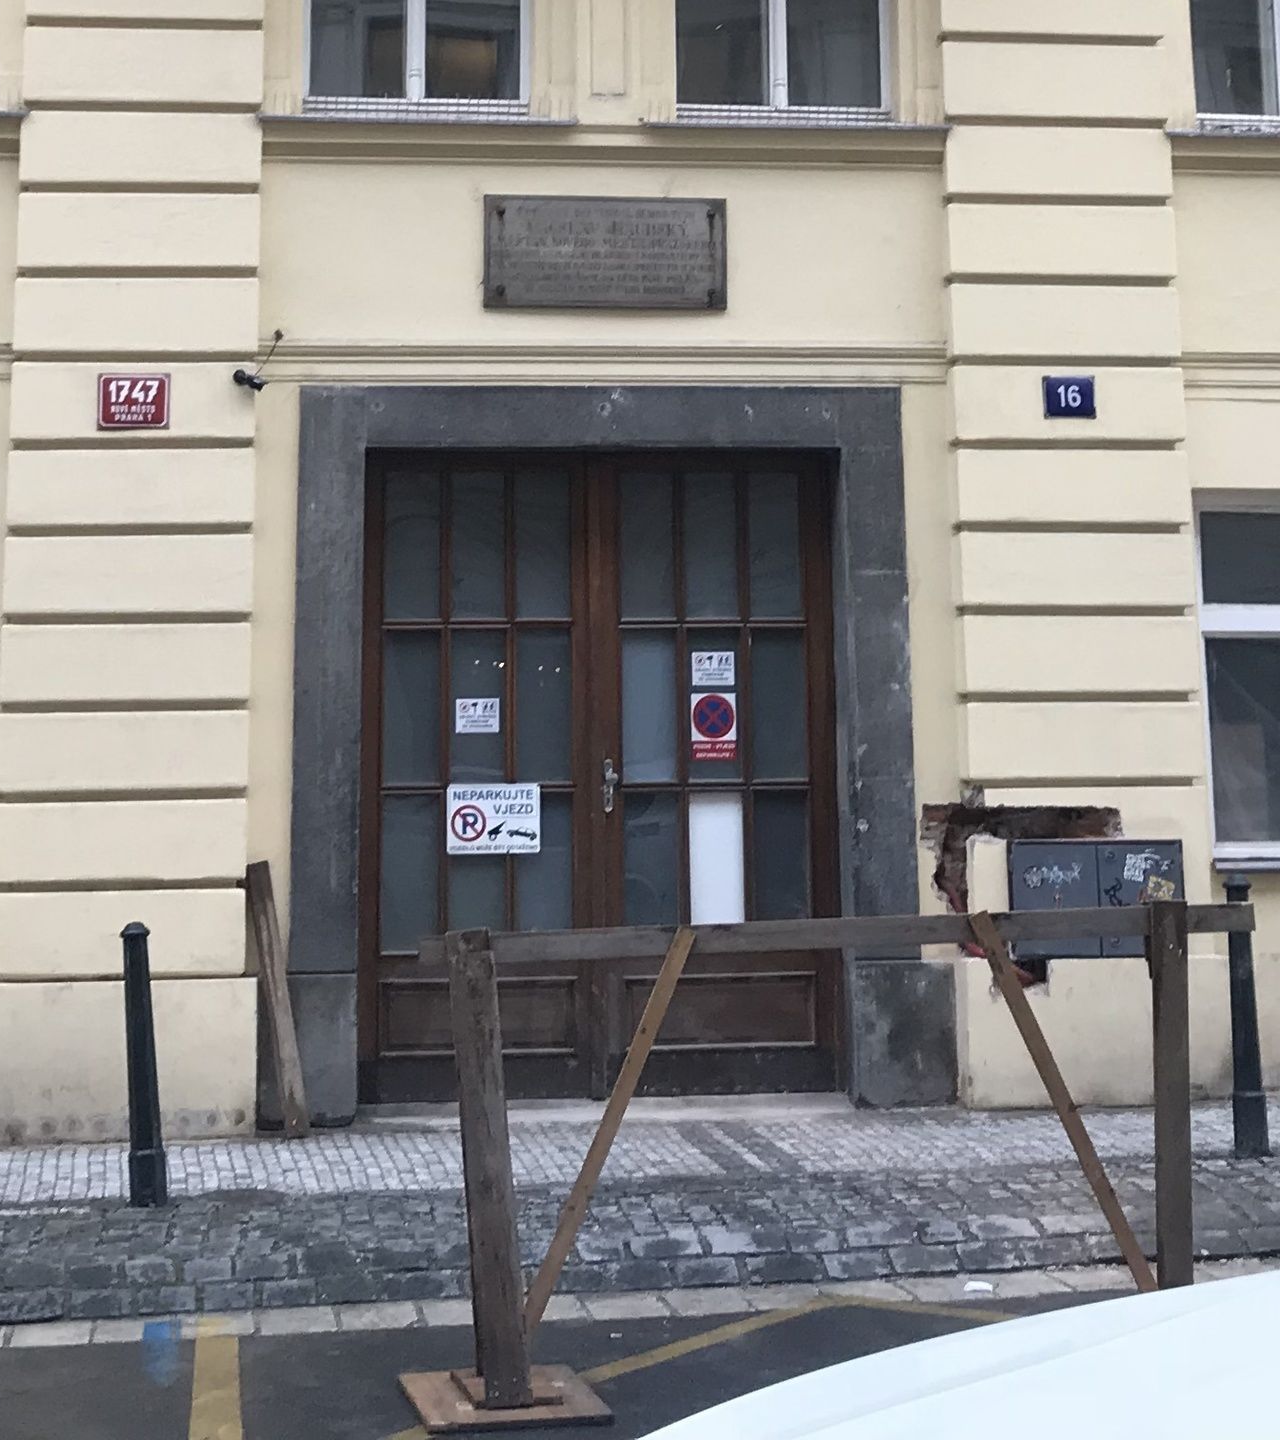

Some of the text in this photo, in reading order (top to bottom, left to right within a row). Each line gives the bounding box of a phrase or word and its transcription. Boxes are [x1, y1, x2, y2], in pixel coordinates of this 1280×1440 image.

[109, 380, 159, 403] 1747
[1057, 384, 1082, 408] 16
[453, 789, 534, 801] NEPARKUJTE
[493, 803, 534, 815] VJEZD
